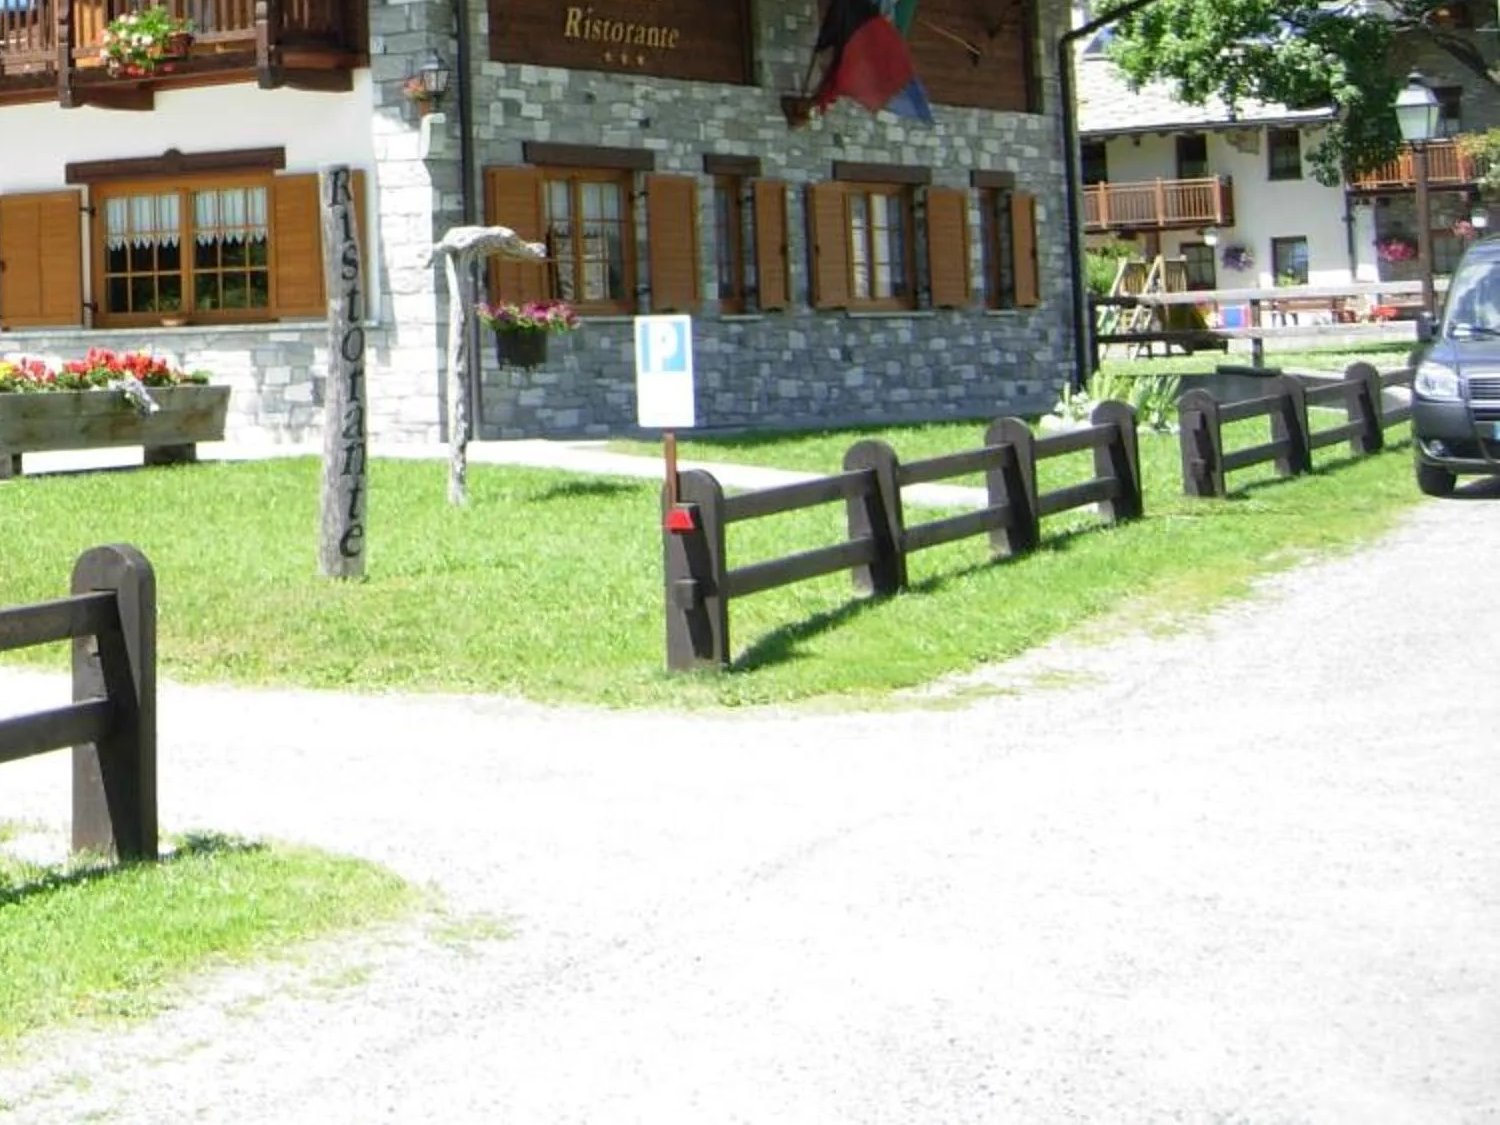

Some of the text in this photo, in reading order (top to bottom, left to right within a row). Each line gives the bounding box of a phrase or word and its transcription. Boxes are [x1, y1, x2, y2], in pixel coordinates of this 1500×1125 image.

[564, 7, 680, 48] Ristorante
[328, 168, 366, 558] Ristorante
[650, 322, 679, 372] P
